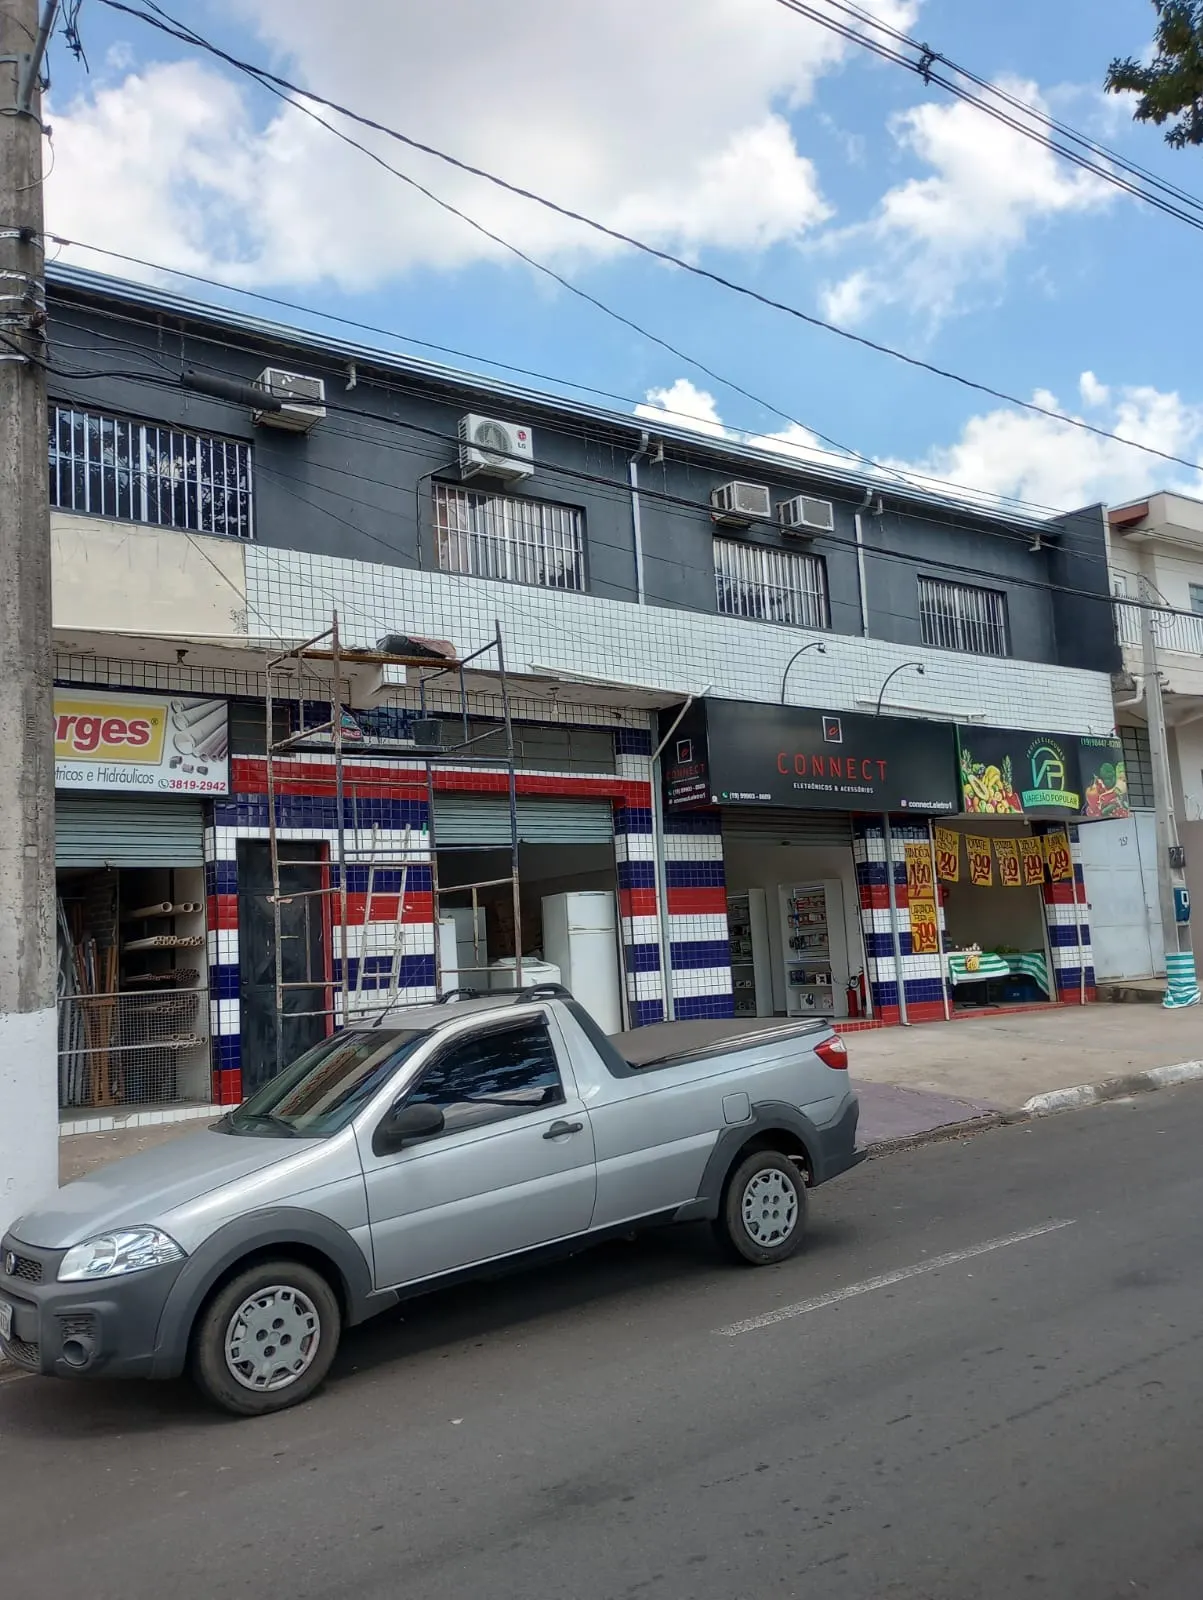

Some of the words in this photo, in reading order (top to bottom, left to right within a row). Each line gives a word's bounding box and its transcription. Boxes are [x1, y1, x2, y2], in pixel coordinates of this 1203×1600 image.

[53, 714, 150, 751] rges
[54, 764, 83, 782] tricos
[86, 769, 94, 782] e
[97, 766, 154, 785] Hidráulicos
[777, 752, 888, 782] CONNECT
[168, 778, 226, 792] 3819-2942
[793, 782, 832, 792] ELETRÔNICOS
[840, 785, 874, 794] ACESSÓRIOS
